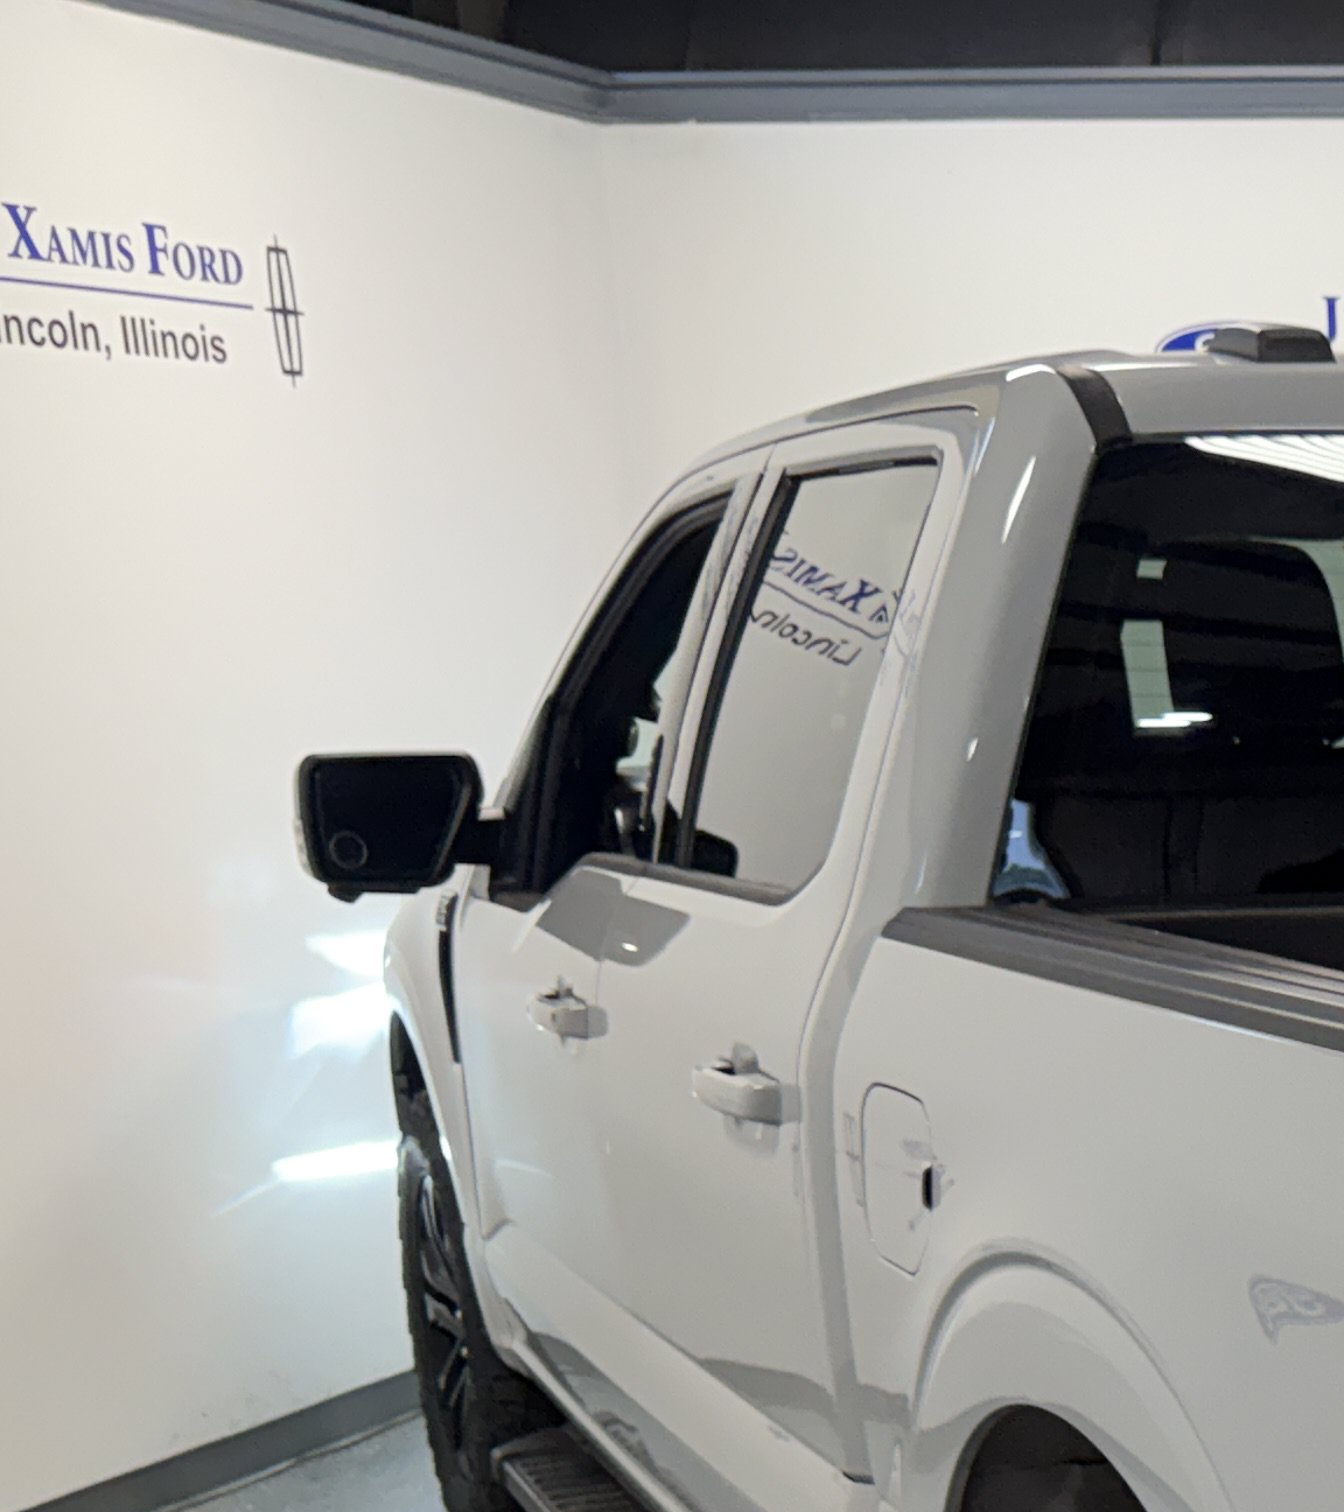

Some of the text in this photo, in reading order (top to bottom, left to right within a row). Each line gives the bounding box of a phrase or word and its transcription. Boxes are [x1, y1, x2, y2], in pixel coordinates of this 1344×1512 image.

[2, 203, 243, 285] XAMIS FORD
[121, 315, 227, 363] Illinois
